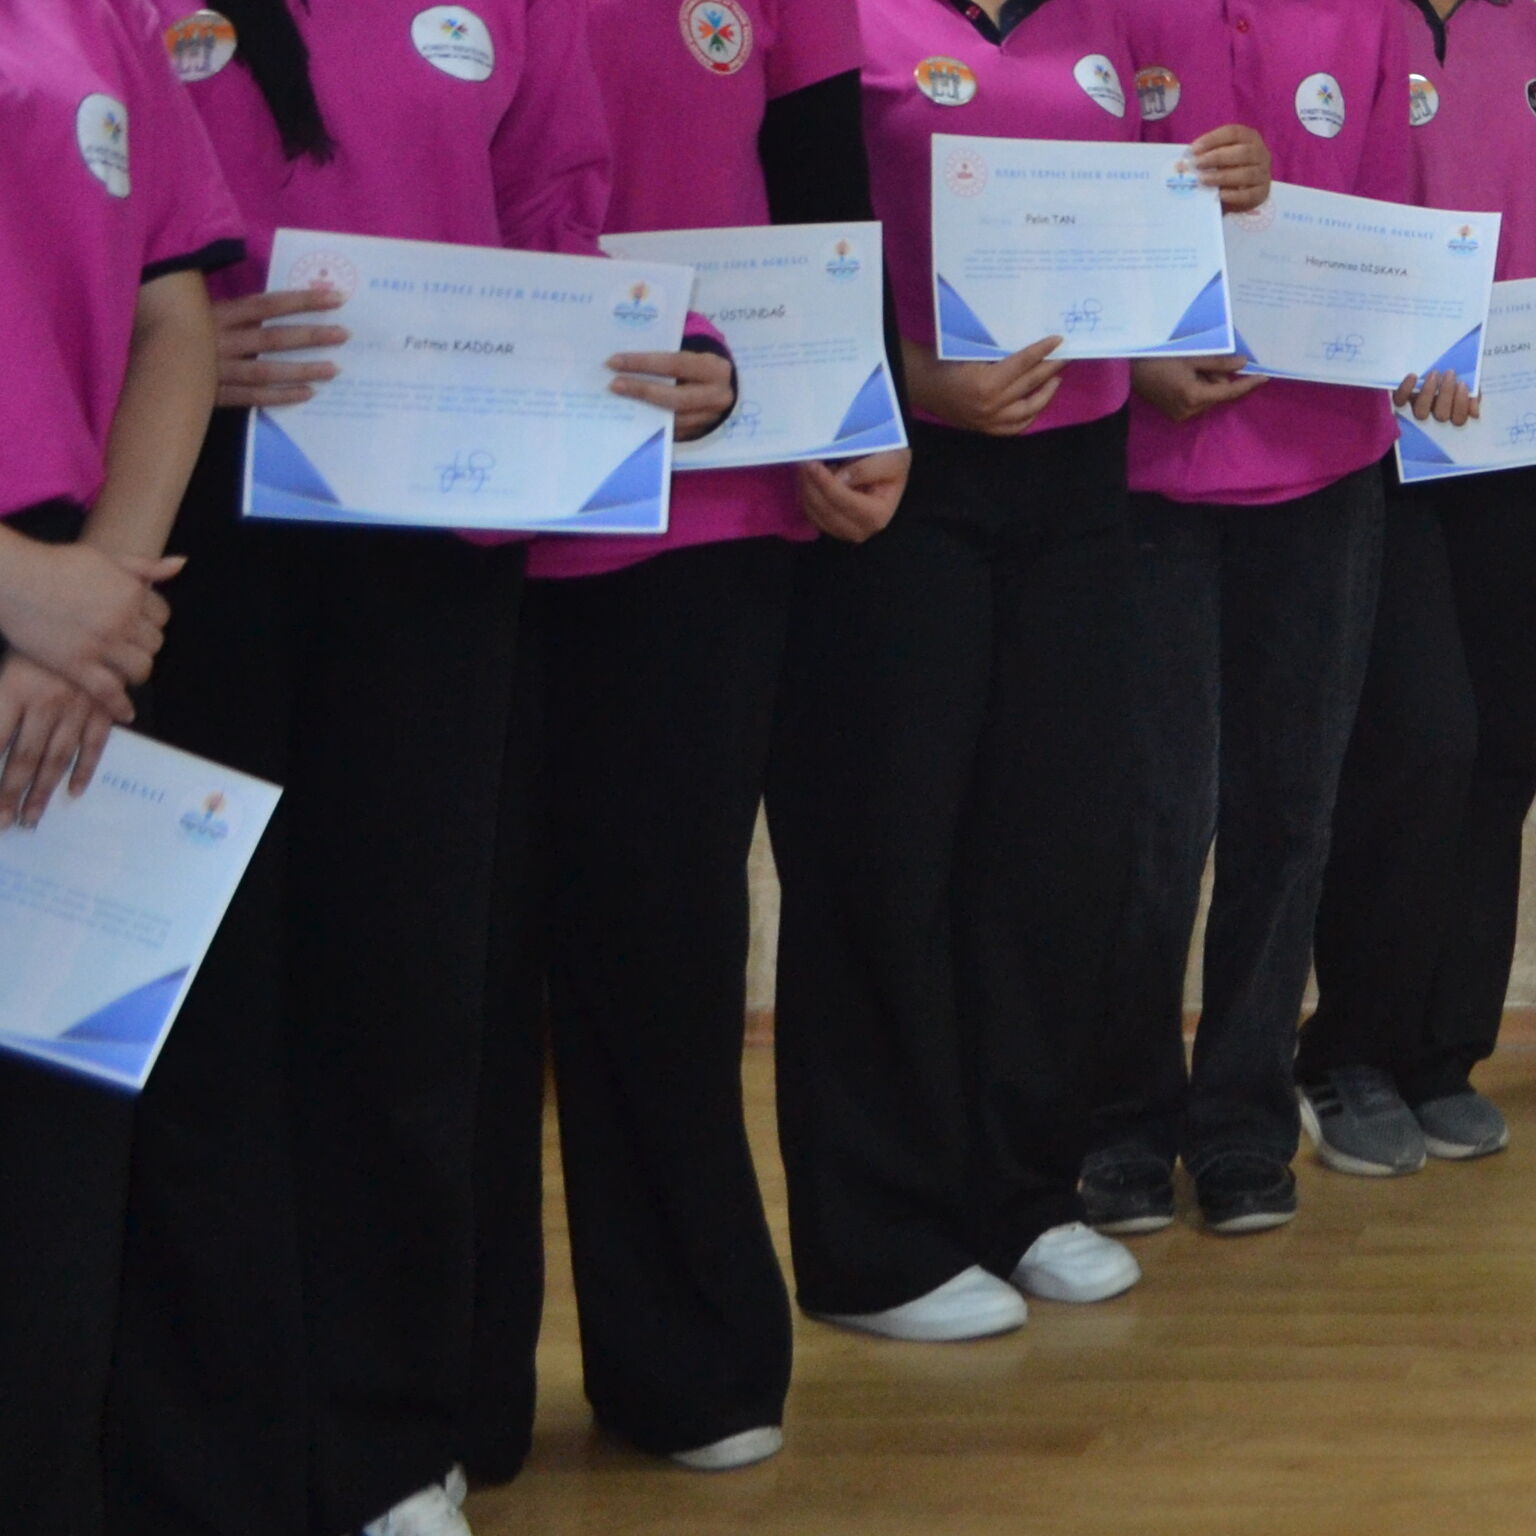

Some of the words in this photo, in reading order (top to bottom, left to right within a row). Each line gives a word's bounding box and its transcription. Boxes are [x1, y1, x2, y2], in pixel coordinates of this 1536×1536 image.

[1051, 213, 1076, 225] TAN
[403, 334, 449, 352] Fatma
[452, 339, 516, 356] KADDAR
